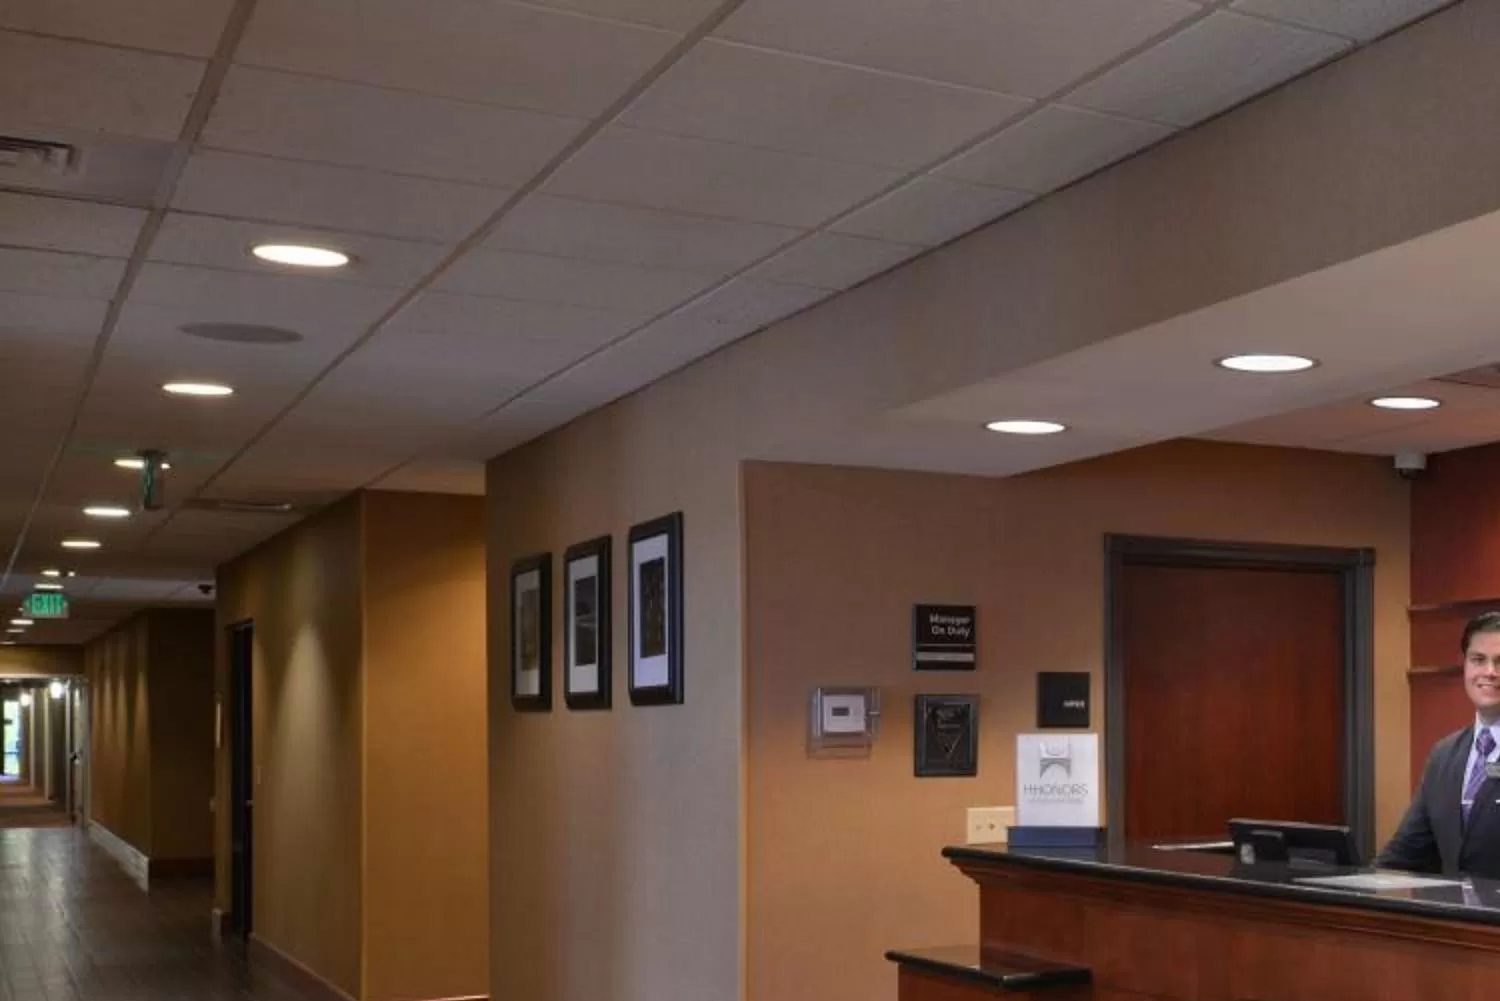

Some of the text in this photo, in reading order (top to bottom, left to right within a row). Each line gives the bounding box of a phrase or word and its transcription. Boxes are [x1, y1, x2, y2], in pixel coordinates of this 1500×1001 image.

[32, 594, 64, 614] EXIT
[929, 614, 970, 625] Manager
[931, 625, 971, 638] On Duty
